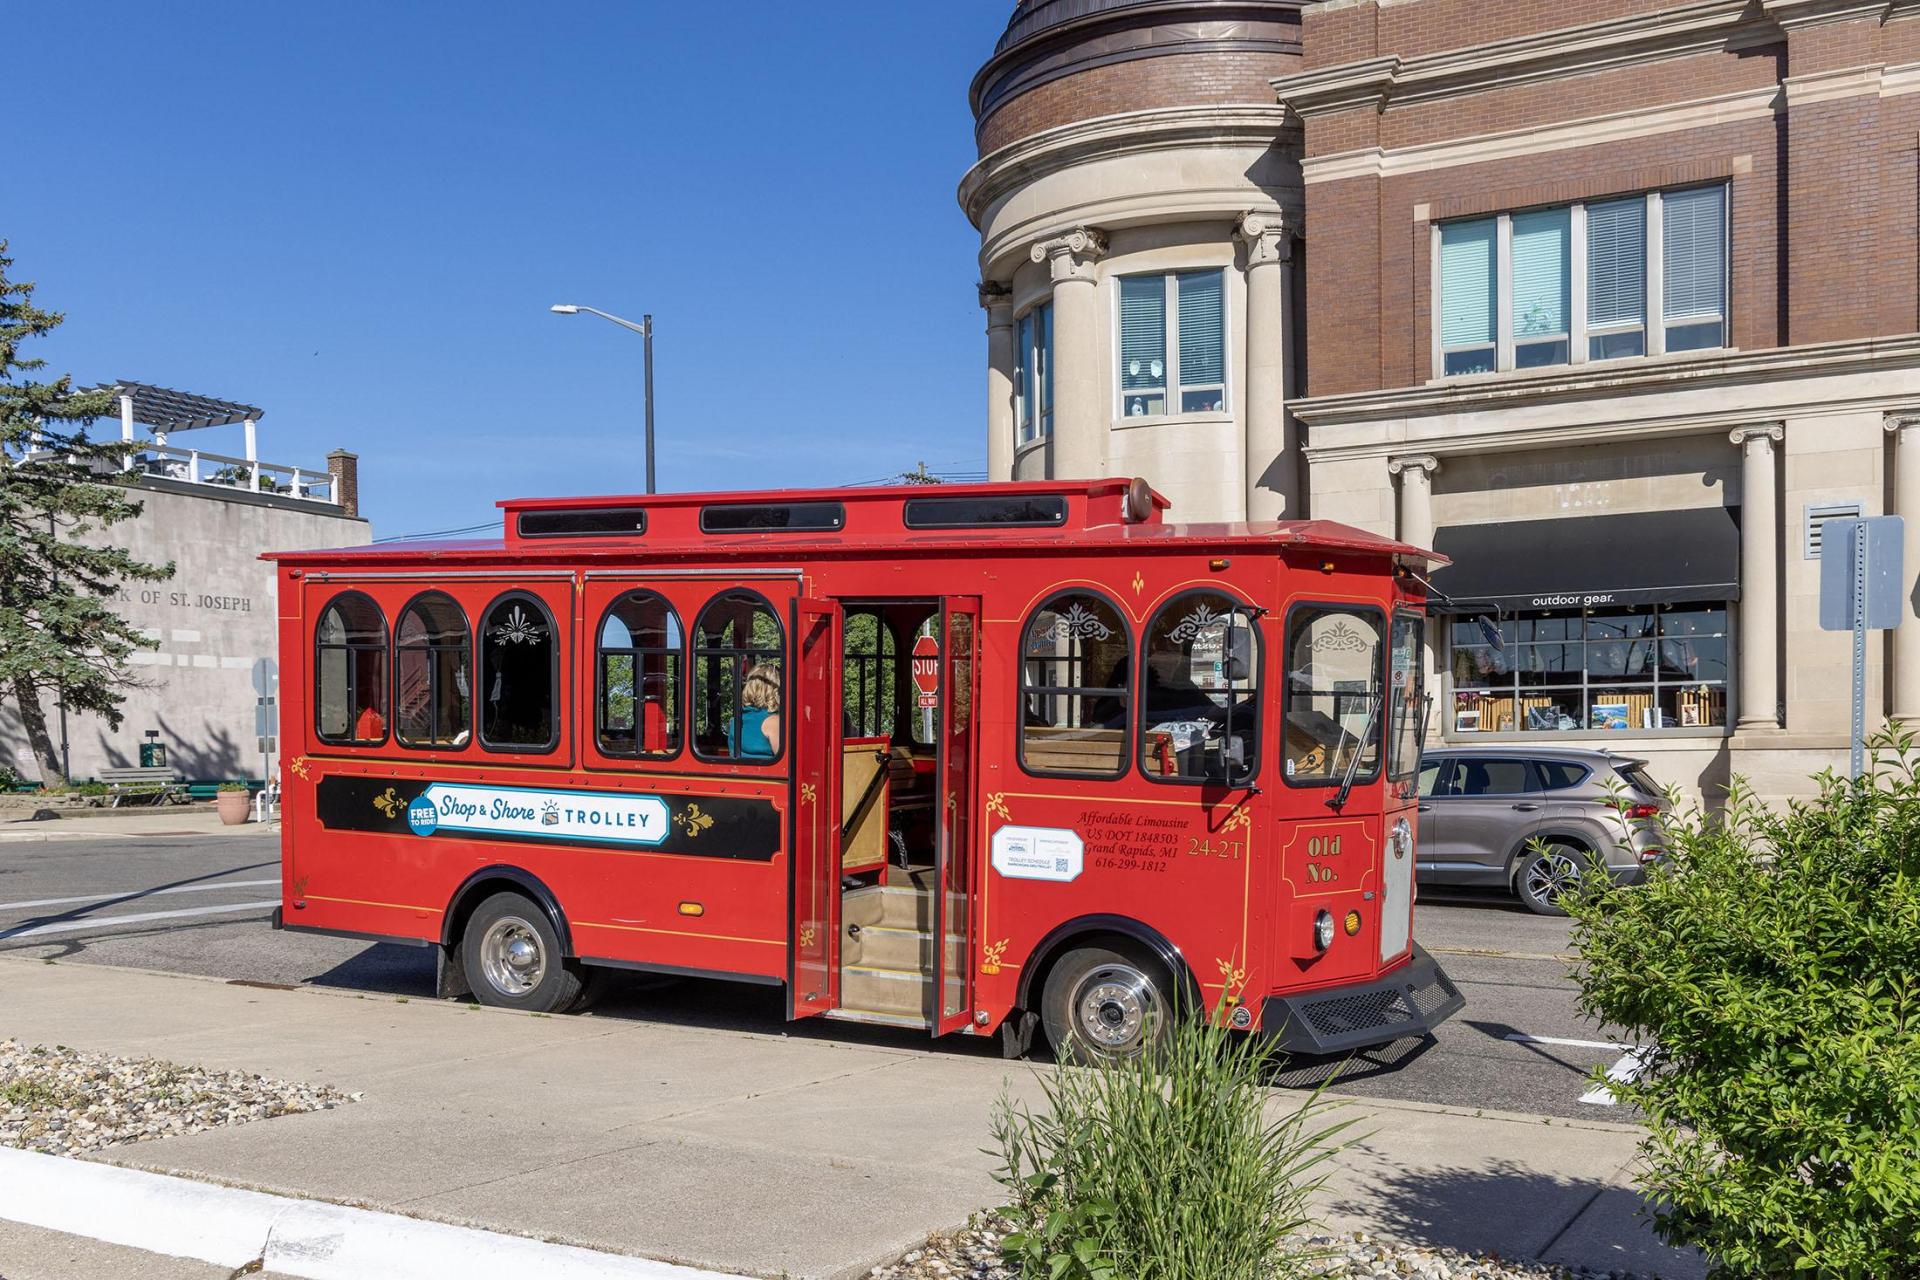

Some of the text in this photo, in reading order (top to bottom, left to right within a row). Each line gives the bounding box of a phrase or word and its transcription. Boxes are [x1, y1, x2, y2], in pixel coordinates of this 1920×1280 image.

[141, 590, 160, 604] OF
[170, 593, 191, 607] ST.
[195, 594, 251, 612] JOSEPH
[1532, 594, 1615, 606] outdoor gear.
[410, 808, 436, 819] FREE
[440, 795, 649, 827] Shop & Shore TROLLEY
[1077, 811, 1190, 829] Affordable Limousine
[420, 818, 436, 826] RIDE!
[1086, 828, 1179, 844] US DOT 1848503
[1083, 842, 1116, 855] Grand
[1118, 844, 1156, 860] Rapids,
[1159, 847, 1179, 858] MI
[1188, 838, 1244, 860] 24-2T
[1307, 834, 1342, 857] Old
[1095, 857, 1167, 873] 616-299-1812
[1306, 862, 1339, 884] No.
